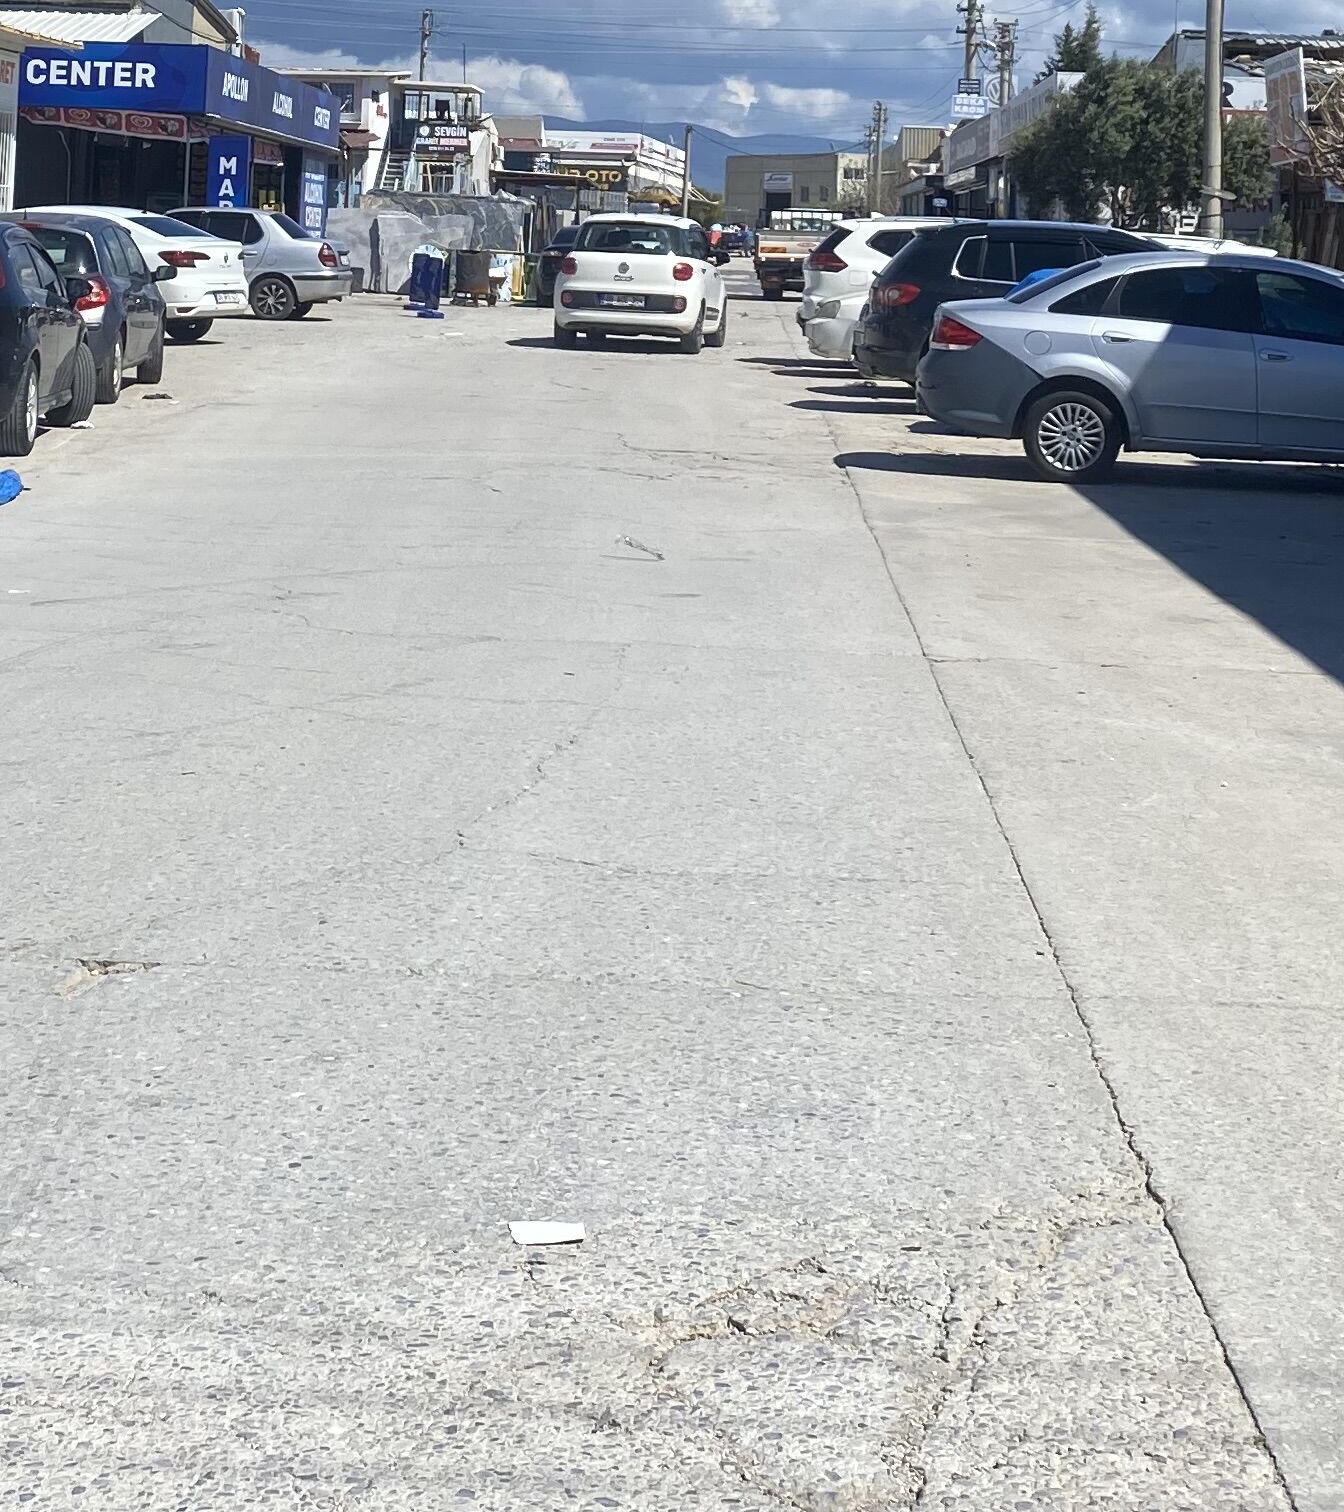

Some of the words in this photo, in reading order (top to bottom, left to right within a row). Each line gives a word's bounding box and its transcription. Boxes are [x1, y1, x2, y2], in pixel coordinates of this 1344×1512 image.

[26, 58, 157, 88] CENTER
[434, 124, 467, 137] SEVGİN
[586, 169, 622, 183] OTO
